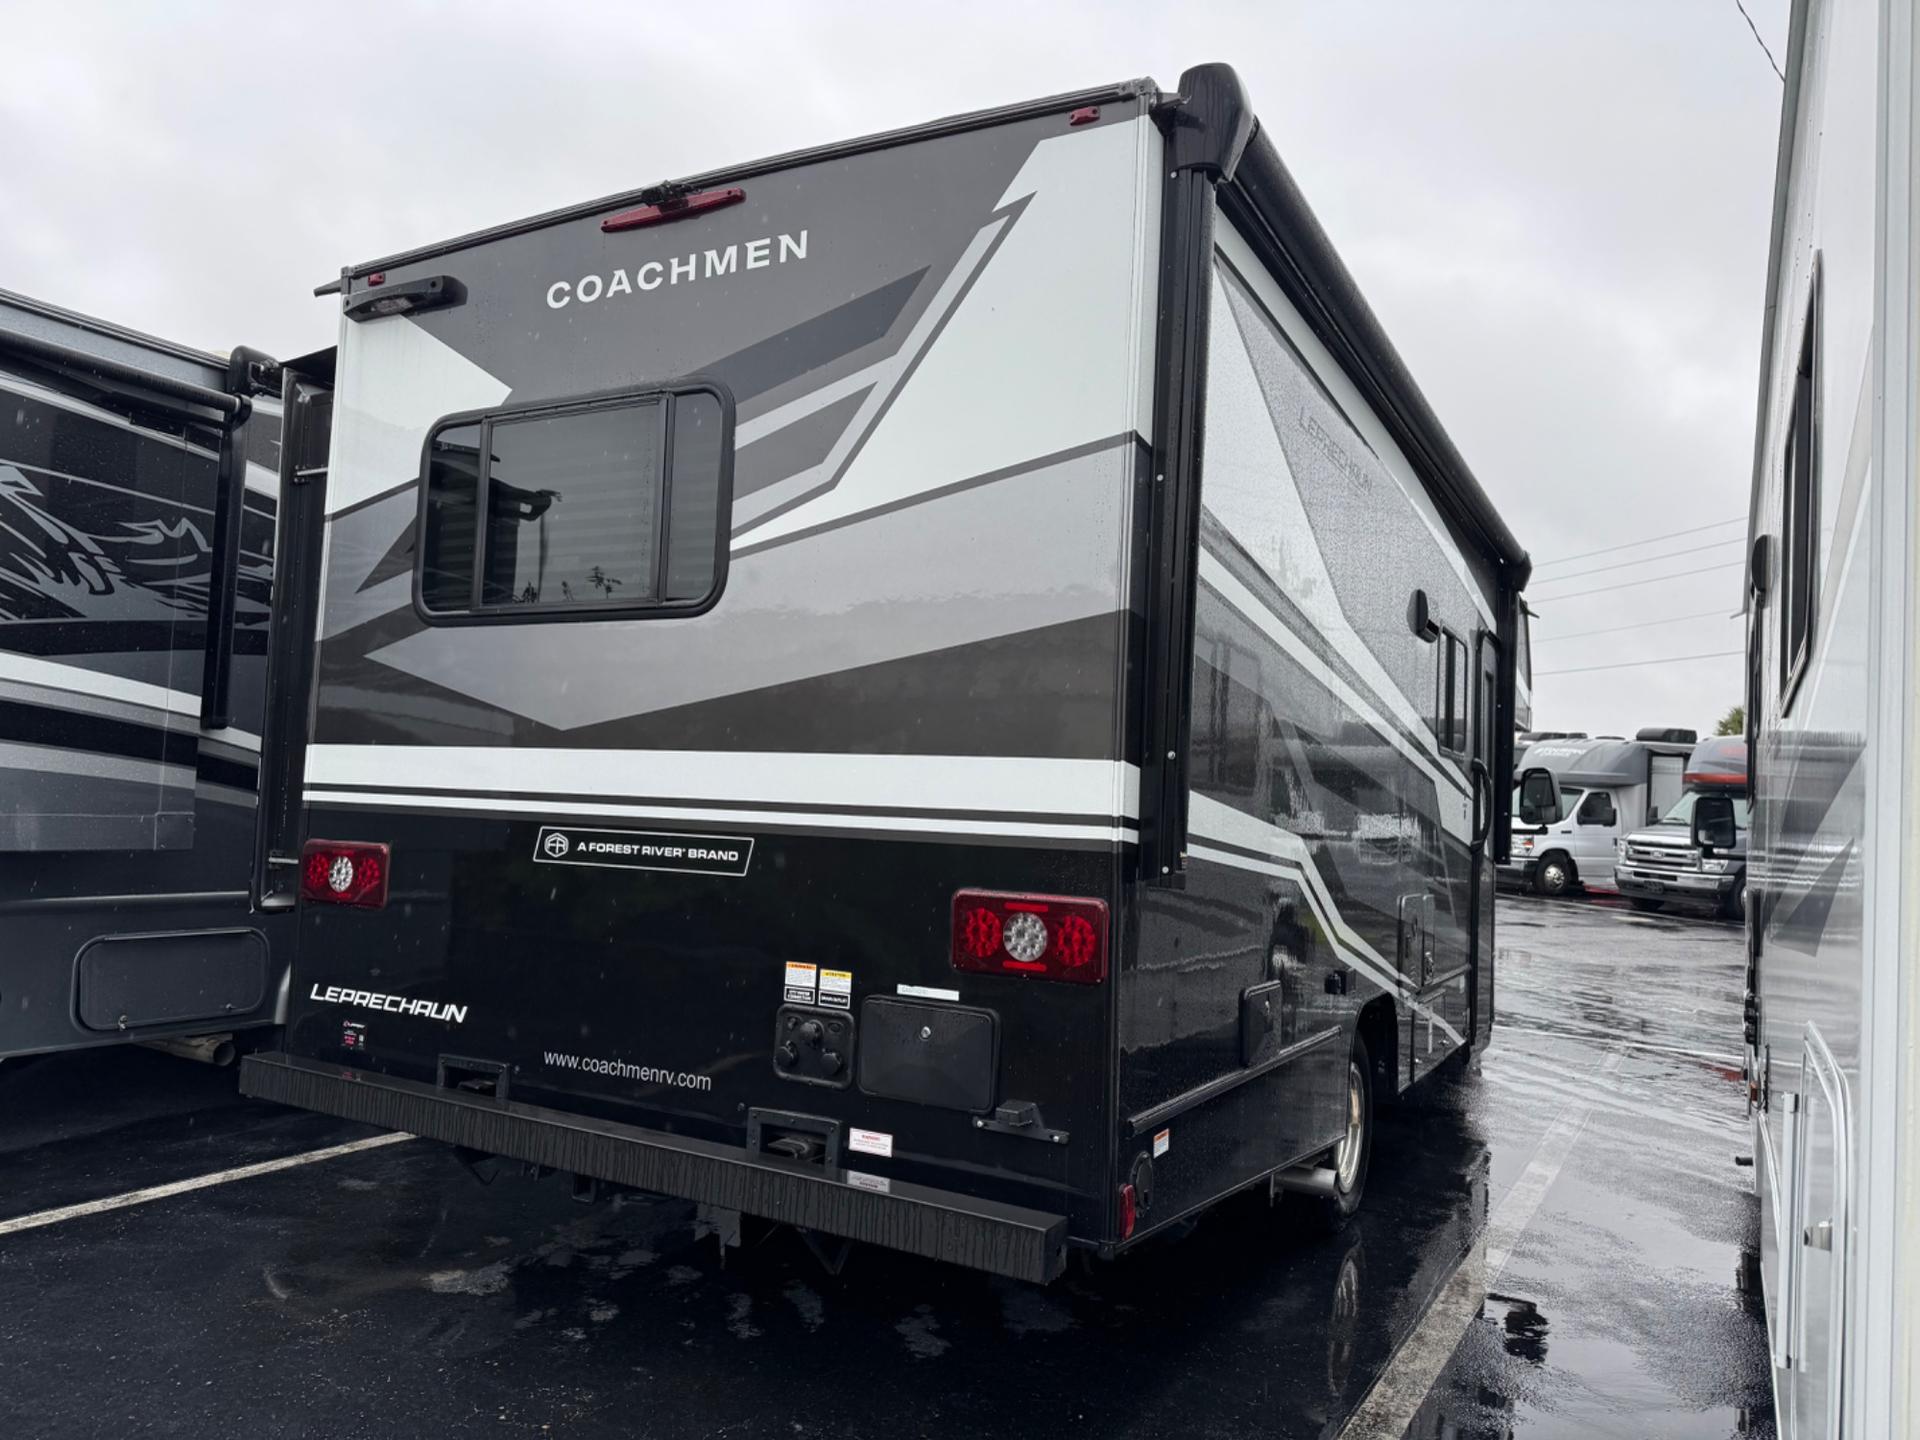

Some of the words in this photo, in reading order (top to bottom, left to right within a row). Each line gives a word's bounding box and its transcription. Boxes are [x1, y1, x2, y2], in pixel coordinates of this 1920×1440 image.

[546, 230, 808, 309] COACHMEN
[577, 842, 587, 852] A
[588, 842, 640, 855] FOREST
[687, 848, 739, 861] BRAND
[310, 983, 468, 1023] LEPRECHAUN
[543, 1051, 712, 1091] www.coachmenrv.com
